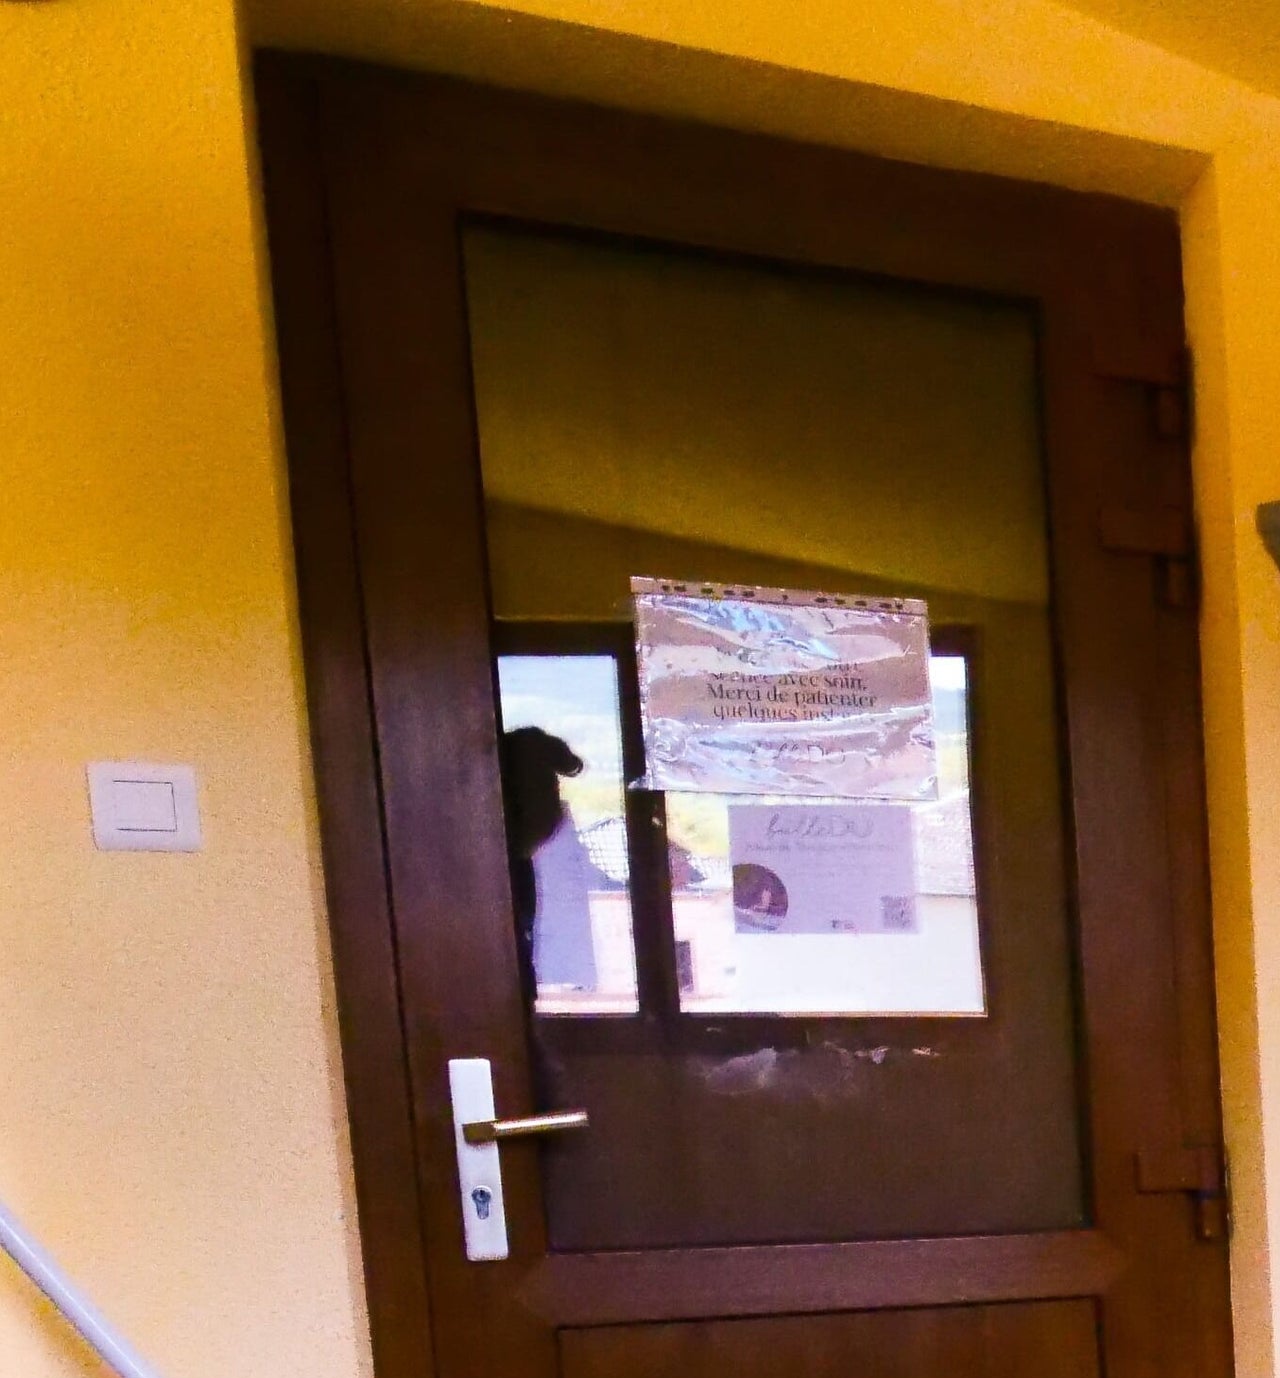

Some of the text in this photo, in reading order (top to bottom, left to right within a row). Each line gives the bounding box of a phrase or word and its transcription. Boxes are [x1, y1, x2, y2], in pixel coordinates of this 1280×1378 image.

[707, 682, 878, 709] Merci de patienter
